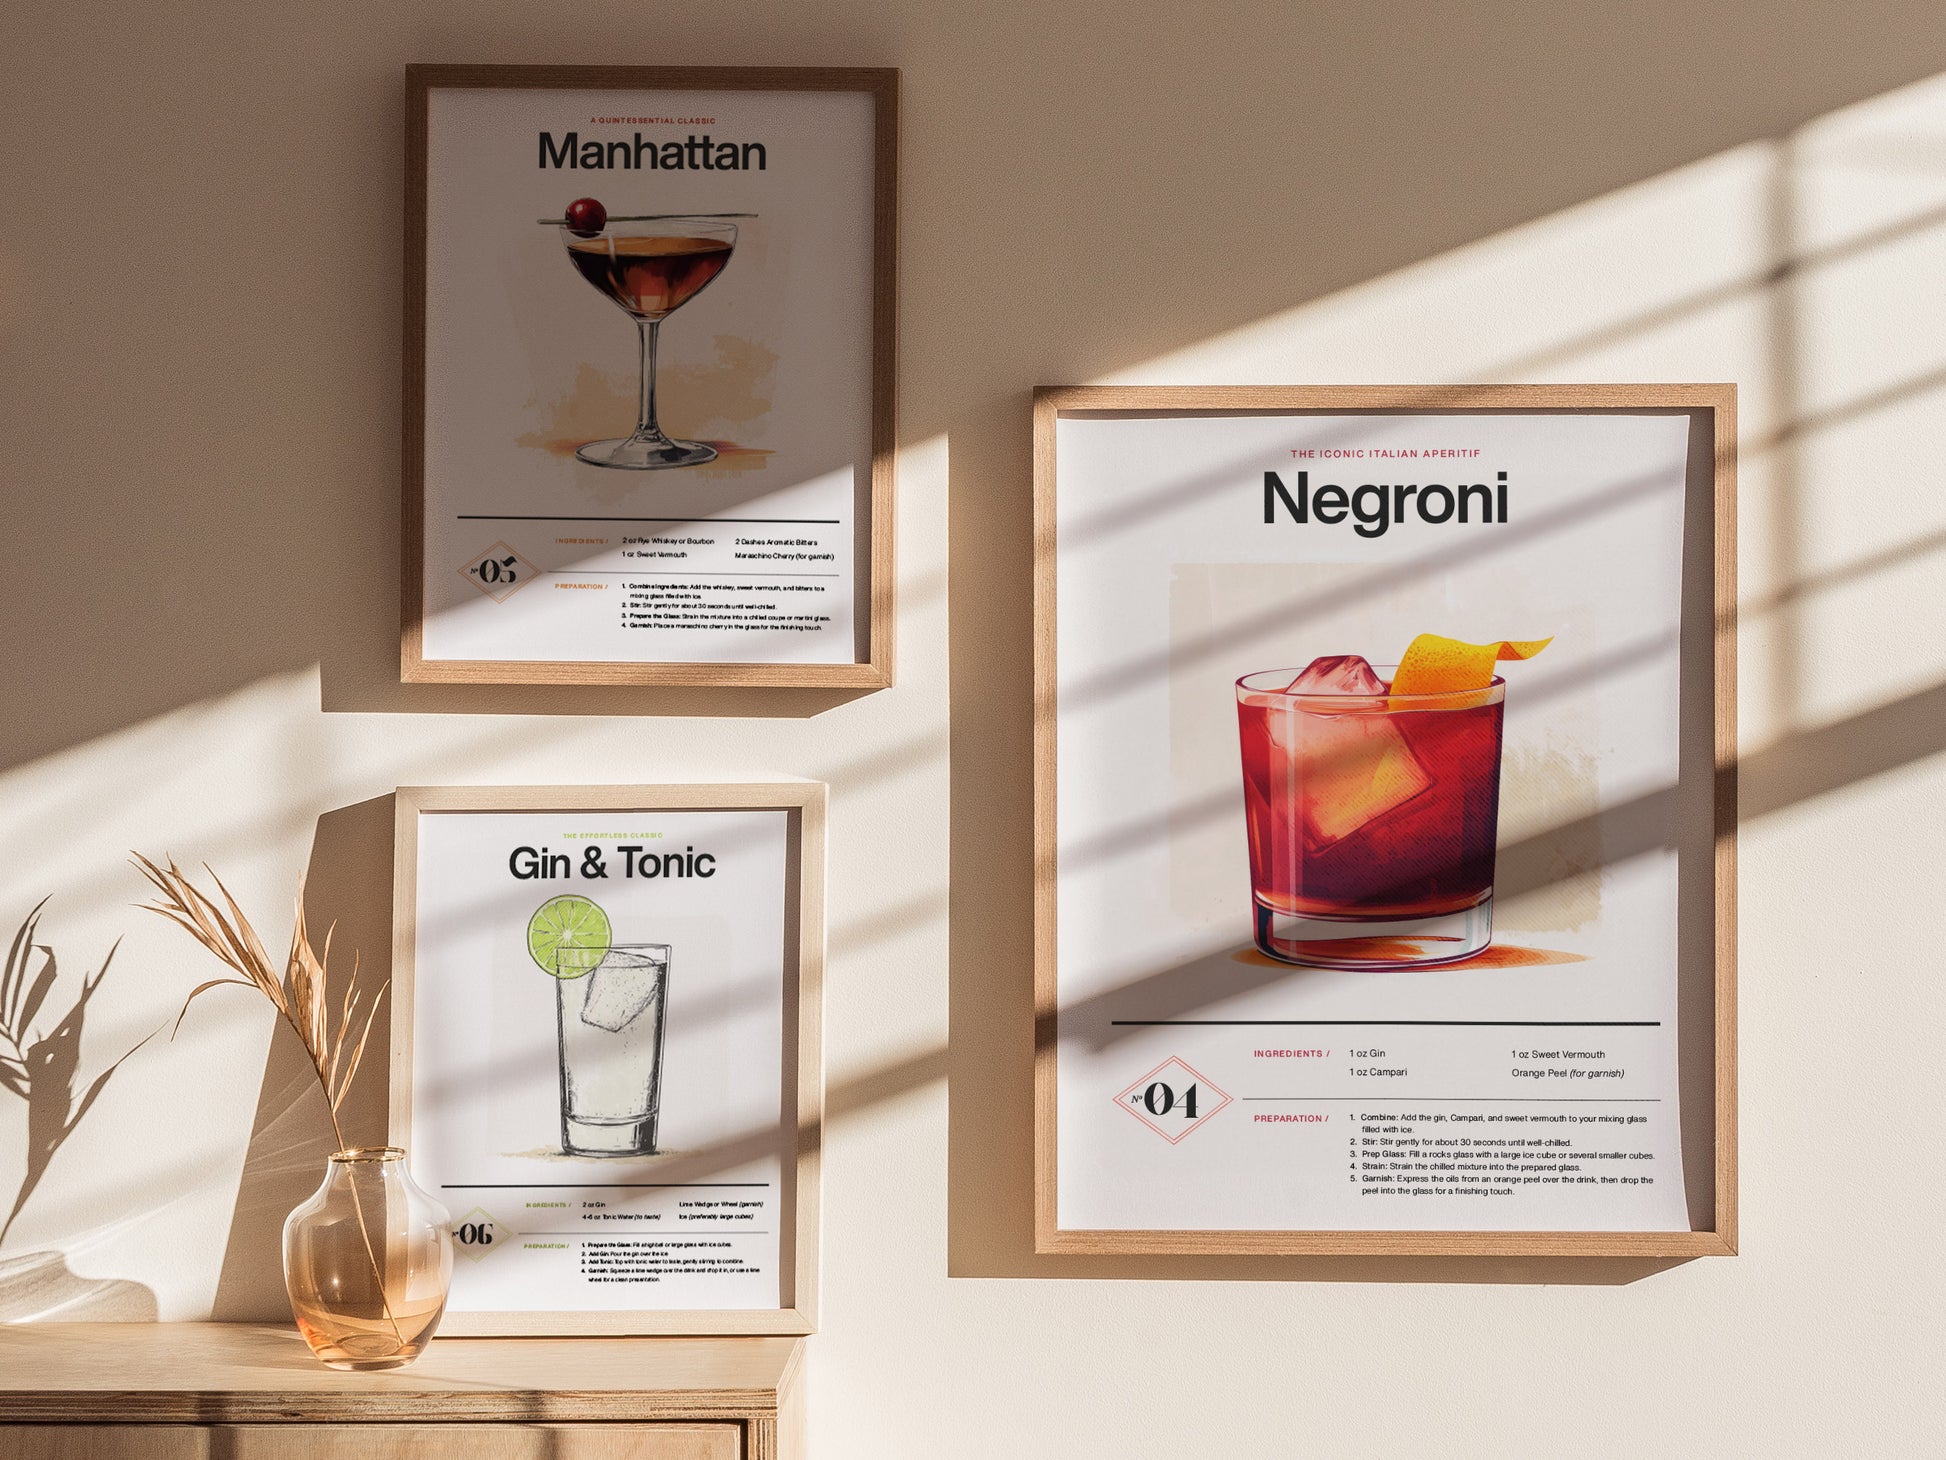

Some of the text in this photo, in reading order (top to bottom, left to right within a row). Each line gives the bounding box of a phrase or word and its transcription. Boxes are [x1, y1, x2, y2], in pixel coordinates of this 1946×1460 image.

[539, 131, 766, 171] Manhattan
[1290, 449, 1480, 459] THE ICONIC ITALIAN APERITIF
[1264, 471, 1508, 538] Negroni
[509, 845, 716, 880] Gin & Tonic
[1254, 1049, 1323, 1058] INGREDIENTS
[1349, 1049, 1354, 1057] 1
[1369, 1049, 1386, 1058] Gin
[1512, 1050, 1516, 1058] 1
[1532, 1050, 1560, 1059] Sweet
[1562, 1050, 1605, 1059] Vermouth
[1350, 1068, 1354, 1076] 1
[1369, 1067, 1407, 1078] Campari
[1512, 1068, 1625, 1080] Orange Peel (for garnish)
[1253, 1114, 1323, 1123] PREPARATION
[1360, 1113, 1399, 1121] Combine:
[1433, 1114, 1448, 1123] gin,
[1450, 1113, 1485, 1123] Campari,
[1487, 1114, 1503, 1122] and
[1568, 1115, 1578, 1123] to
[1579, 1116, 1597, 1124] your
[1598, 1115, 1625, 1125] mixing
[1626, 1115, 1647, 1125] glass
[1400, 1126, 1415, 1134] ice.
[1350, 1138, 1357, 1146] 2.
[1362, 1138, 1378, 1146] Stir:
[1380, 1138, 1394, 1146] Stir
[1395, 1138, 1420, 1147] gently
[1422, 1138, 1433, 1146] for
[1435, 1138, 1458, 1146] about
[1460, 1138, 1471, 1146] 30
[1526, 1139, 1572, 1147] well-chilled.
[1350, 1150, 1357, 1158] 3.
[1362, 1150, 1381, 1159] Prep
[1382, 1150, 1407, 1158] Glass:
[1409, 1150, 1420, 1158] Fill
[1429, 1150, 1452, 1158] rocks
[1453, 1150, 1474, 1160] glass
[1500, 1151, 1521, 1160] large
[1522, 1151, 1535, 1159] ice
[1536, 1151, 1557, 1159] cube
[1629, 1152, 1655, 1160] cubes.
[1350, 1162, 1357, 1170] 4.
[1362, 1162, 1388, 1170] Strain:
[1389, 1162, 1413, 1170] Strain
[1457, 1163, 1488, 1171] mixture
[1489, 1163, 1505, 1171] into
[1506, 1163, 1519, 1171] the
[1521, 1163, 1557, 1172] prepared
[1558, 1163, 1581, 1173] glass.
[1350, 1174, 1357, 1182] 5.
[1362, 1174, 1395, 1182] Garnish:
[1397, 1174, 1429, 1184] Express
[1431, 1175, 1444, 1183] the
[1445, 1175, 1459, 1183] oils
[1461, 1175, 1480, 1183] from
[1493, 1177, 1522, 1185] orange
[1523, 1175, 1540, 1184] peel
[1576, 1176, 1598, 1184] drink,
[1600, 1176, 1618, 1184] then
[1620, 1176, 1639, 1185] drop
[1640, 1176, 1654, 1184] the
[1362, 1187, 1379, 1196] peel
[1380, 1187, 1396, 1195] into
[1397, 1187, 1411, 1195] the
[1412, 1187, 1434, 1196] glass
[1435, 1187, 1447, 1195] for
[1455, 1187, 1488, 1197] finishing
[1490, 1187, 1515, 1195] touch.
